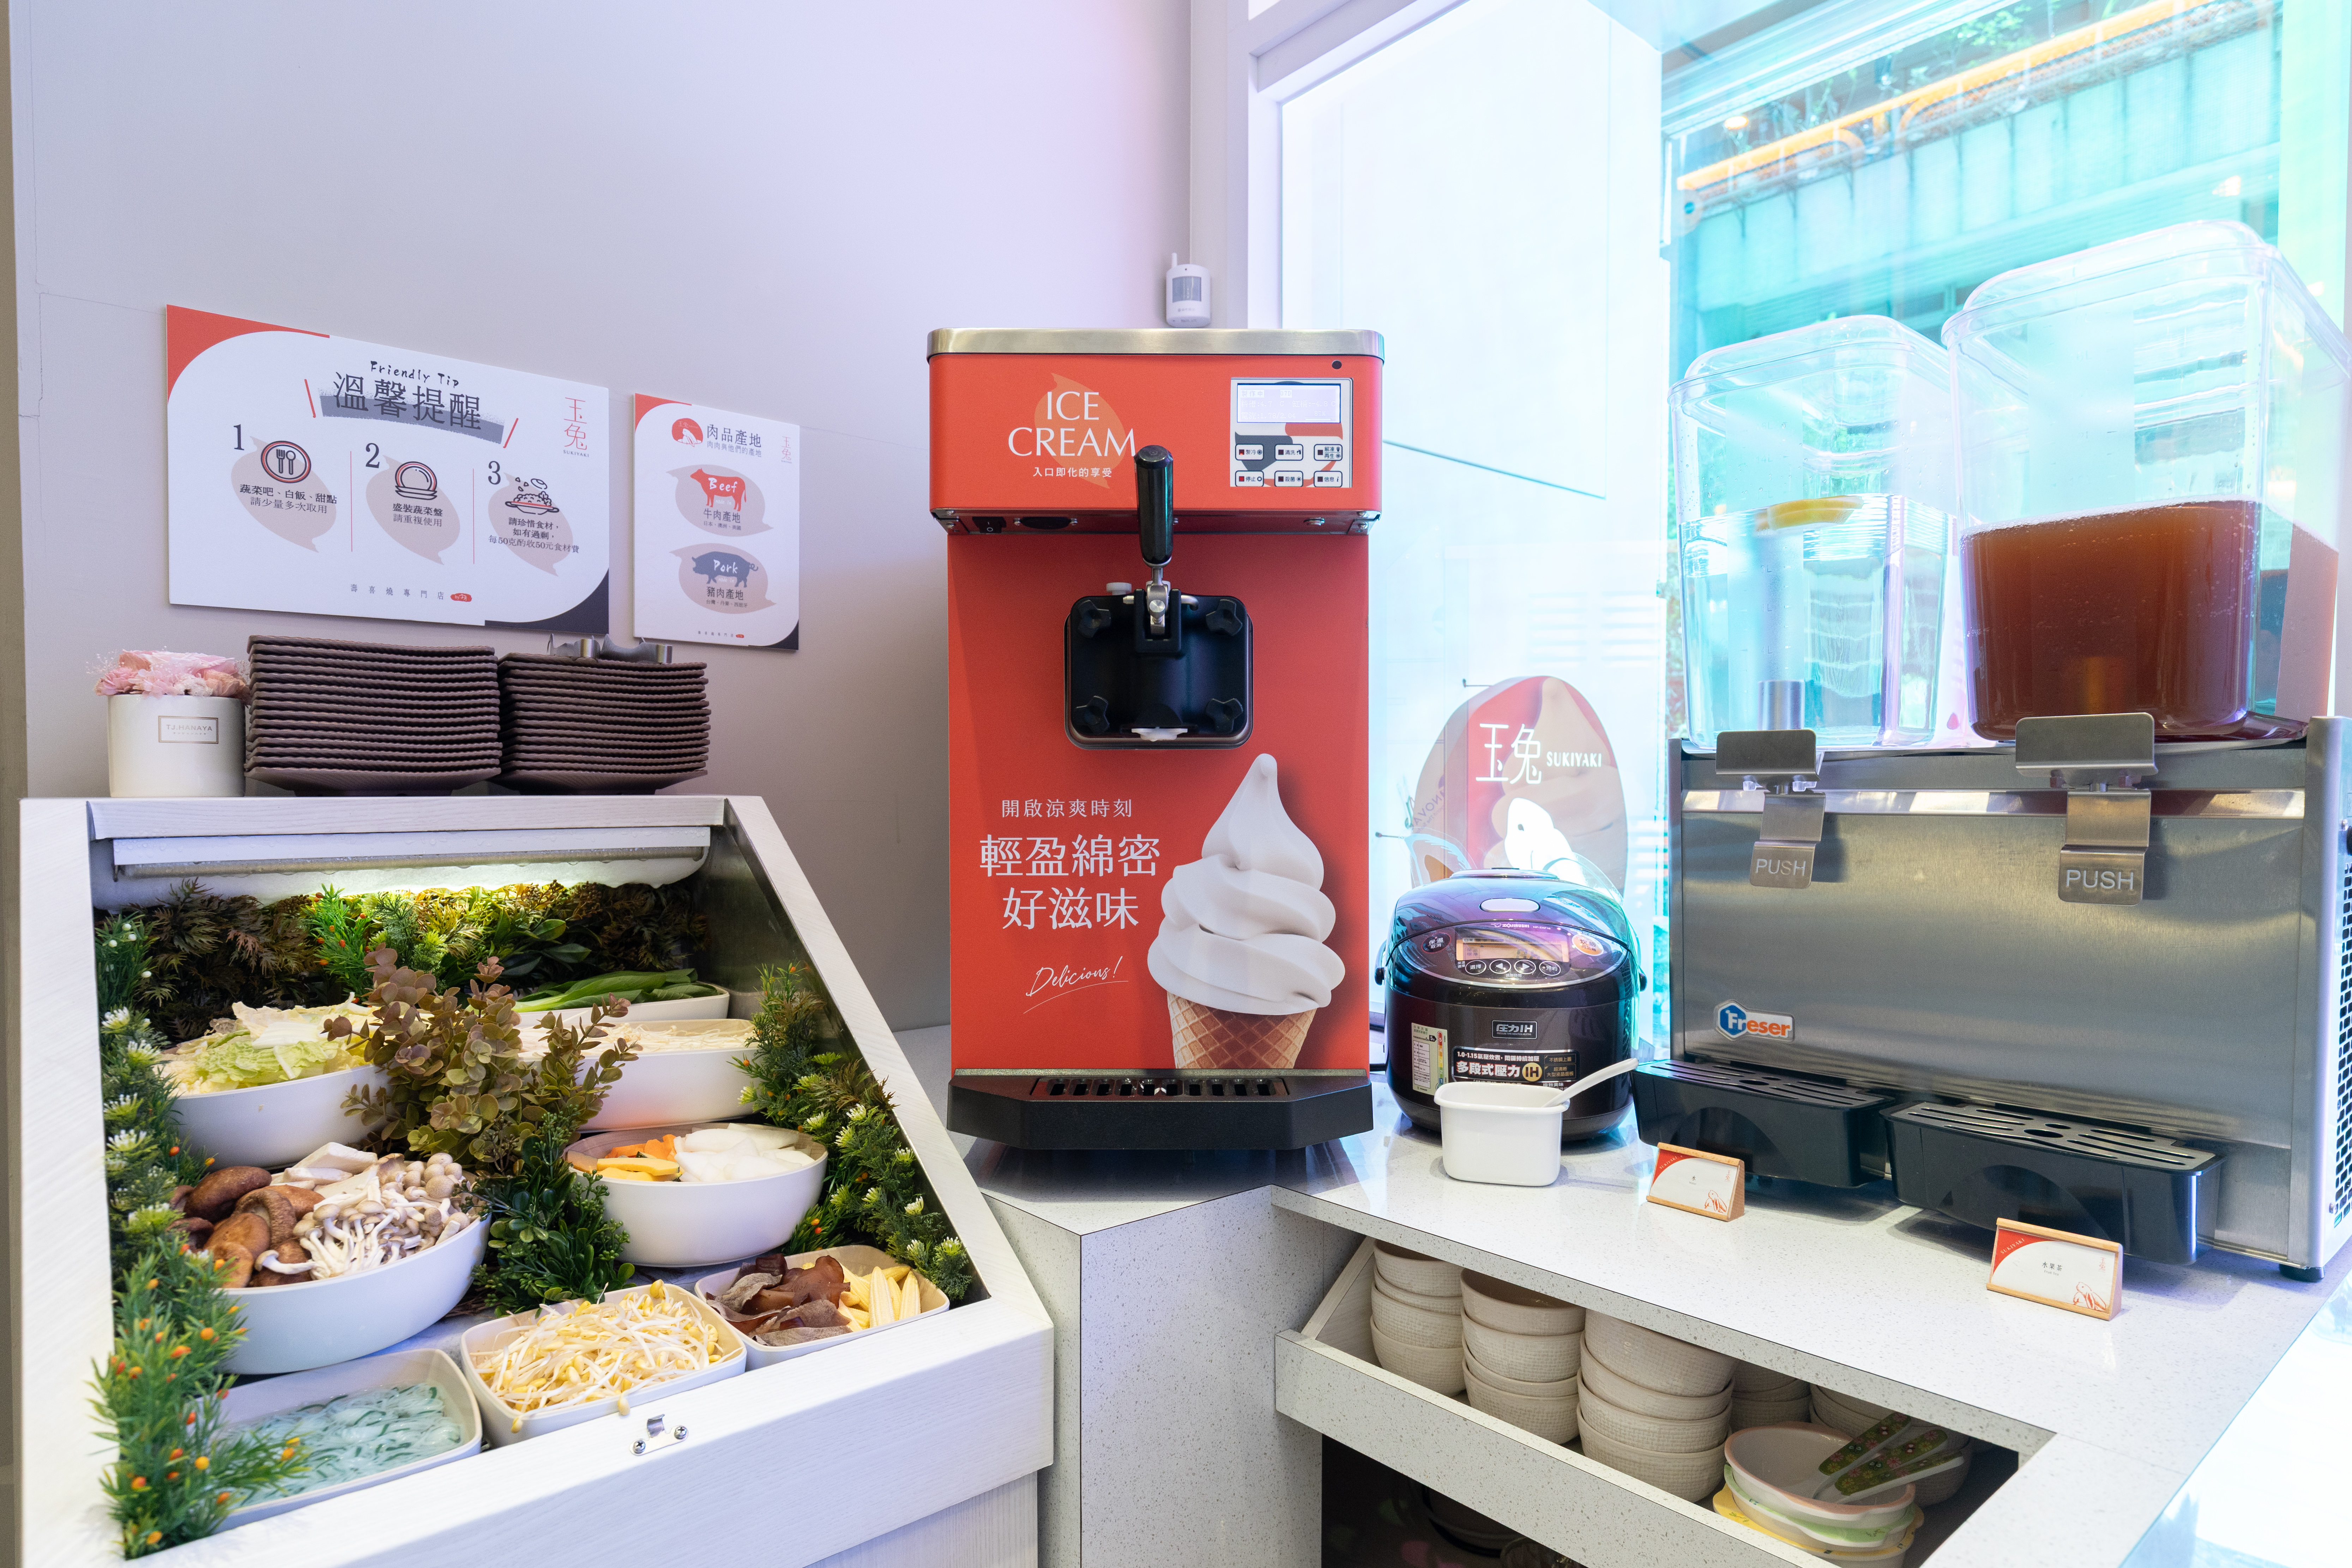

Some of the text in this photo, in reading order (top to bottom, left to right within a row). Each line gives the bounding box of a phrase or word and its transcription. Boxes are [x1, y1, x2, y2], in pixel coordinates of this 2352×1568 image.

[370, 361, 459, 388] Friendly Tip
[333, 372, 481, 430] 溫馨提醒
[1047, 391, 1099, 420] ICE
[564, 397, 587, 450] 玉兔
[233, 424, 245, 451] 1
[707, 424, 761, 447] 肉品產地
[1008, 427, 1136, 457] CREAM
[366, 443, 380, 469] 2
[563, 450, 589, 458] SUKIYAKI
[707, 440, 762, 457] 肉肉與他們的產地
[781, 436, 791, 460] 玉兔
[488, 461, 501, 485] 3
[1033, 467, 1112, 478] 入口即化的享受
[708, 477, 738, 493] Beef
[240, 484, 337, 504] 蔬菜吧、白飯、甜點
[251, 496, 327, 513] 請少量多次取用
[393, 503, 443, 517] 盛裝蔬菜盤
[393, 514, 442, 527] 請重複使用
[508, 517, 559, 530] 請珍惜食材，
[704, 508, 740, 523] 牛肉產地
[513, 528, 554, 540] 如有過剩，
[488, 535, 579, 553] 每50克酌收50元食材費
[713, 559, 738, 574] Pork
[350, 584, 444, 600] 壽喜燒專門店
[706, 586, 743, 600] 豬肉產地
[1476, 723, 1542, 784] 玉兔
[1546, 751, 1602, 767] SUKIYAKI
[1002, 799, 1132, 818] 開啟涼爽時刻
[979, 834, 1160, 877] 輕盈綿密
[1755, 859, 1806, 876] PUSH
[2066, 869, 2134, 890] PUSH
[1002, 887, 1139, 930] 好滋味
[1025, 956, 1123, 997] Delicious!
[1725, 1009, 1791, 1036] Freser
[1457, 1061, 1539, 1078] 多段式壓力 IH
[1659, 1156, 1678, 1170] SUKIYAKI
[2000, 1238, 2025, 1255] SUKIYAKI
[2042, 1261, 2063, 1272] 水果茶
[2098, 1257, 2106, 1271] 玉兔
